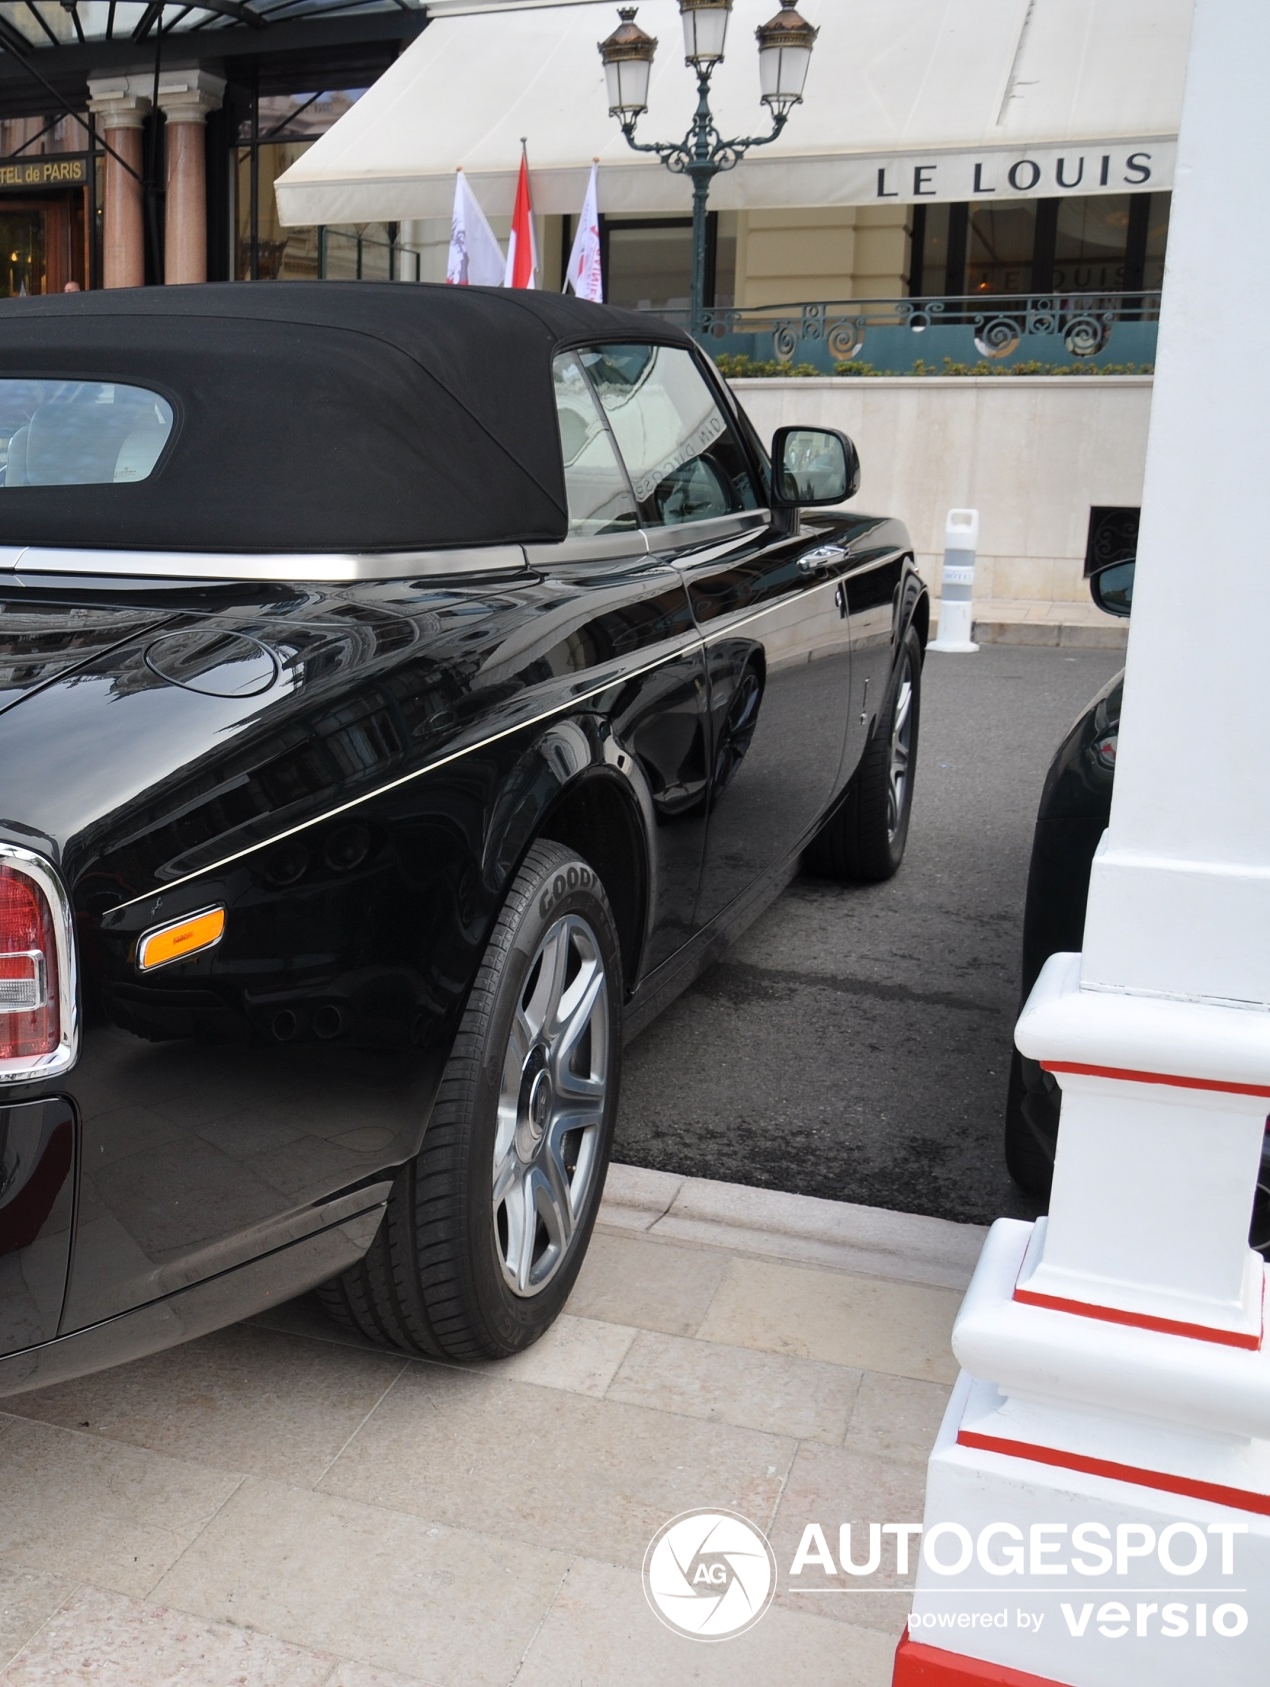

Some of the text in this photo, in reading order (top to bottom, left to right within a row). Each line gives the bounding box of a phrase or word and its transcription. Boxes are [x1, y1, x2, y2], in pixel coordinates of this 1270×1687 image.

[25, 166, 40, 182] de
[44, 162, 82, 181] PARIS
[876, 152, 1153, 198] LE LOUIS
